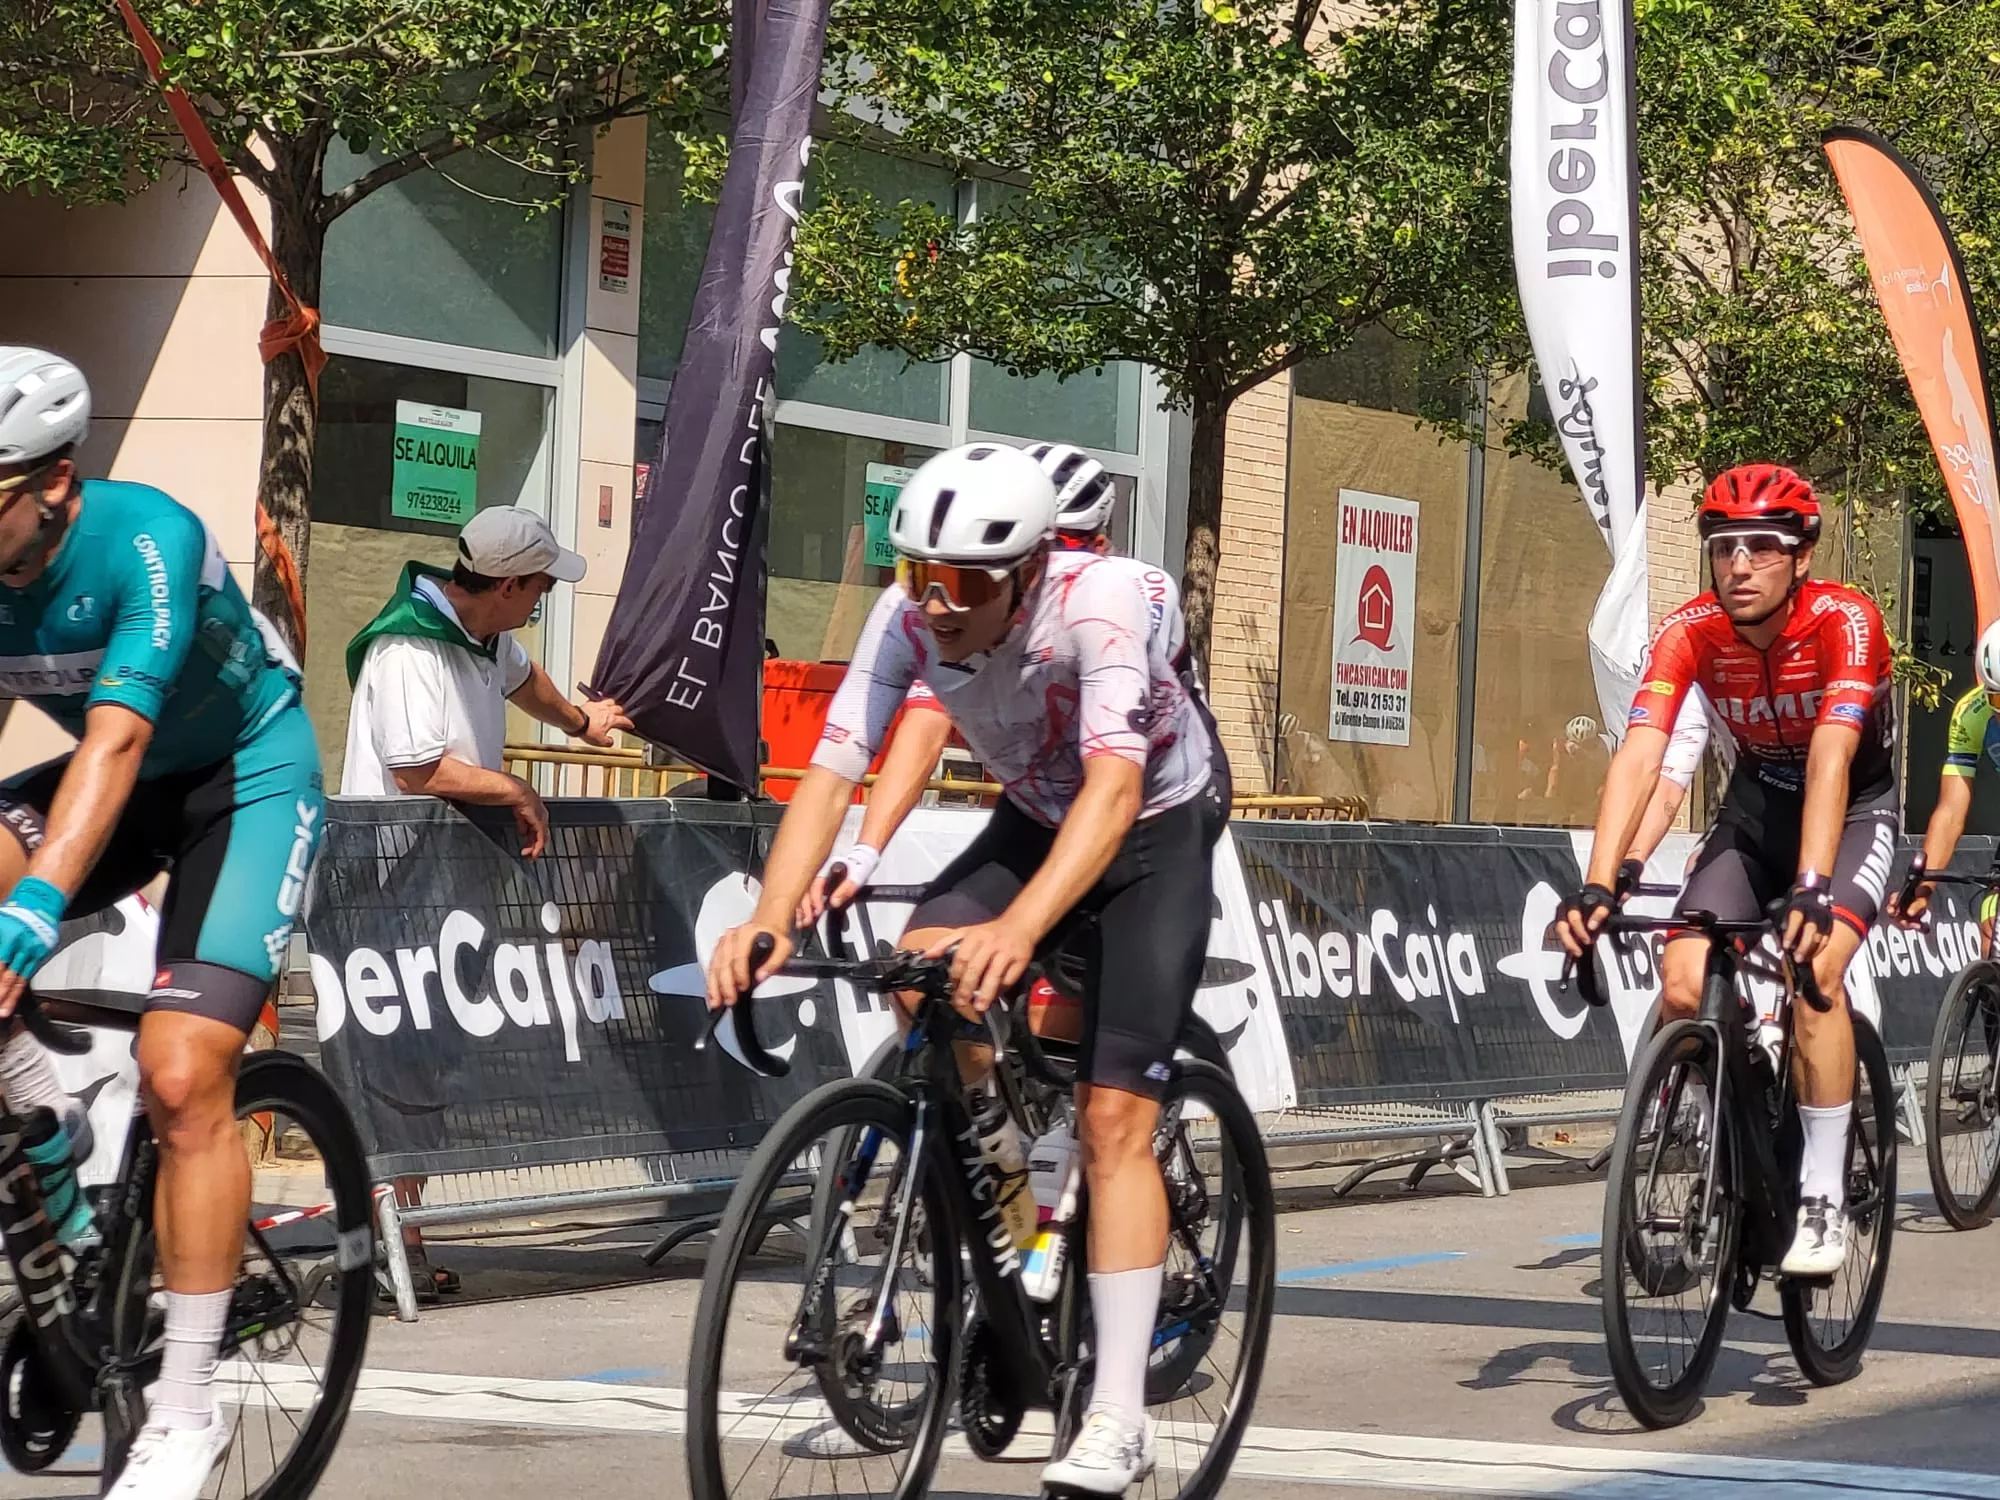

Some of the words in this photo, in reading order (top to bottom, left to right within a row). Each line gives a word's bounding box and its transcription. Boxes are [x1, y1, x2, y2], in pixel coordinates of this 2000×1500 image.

[395, 437, 415, 461] SE
[416, 440, 477, 471] ALQUILA
[407, 491, 462, 514] 974238244
[865, 494, 881, 516] SE
[1342, 505, 1357, 545] EN
[1359, 508, 1413, 554] ALQUILER
[1336, 663, 1408, 690] FINCASVICAM.COM
[1353, 691, 1369, 709] 974
[1371, 693, 1381, 711] 21
[1382, 694, 1394, 712] 53
[1395, 696, 1406, 713] 31
[1258, 899, 1487, 1025] iberCaja
